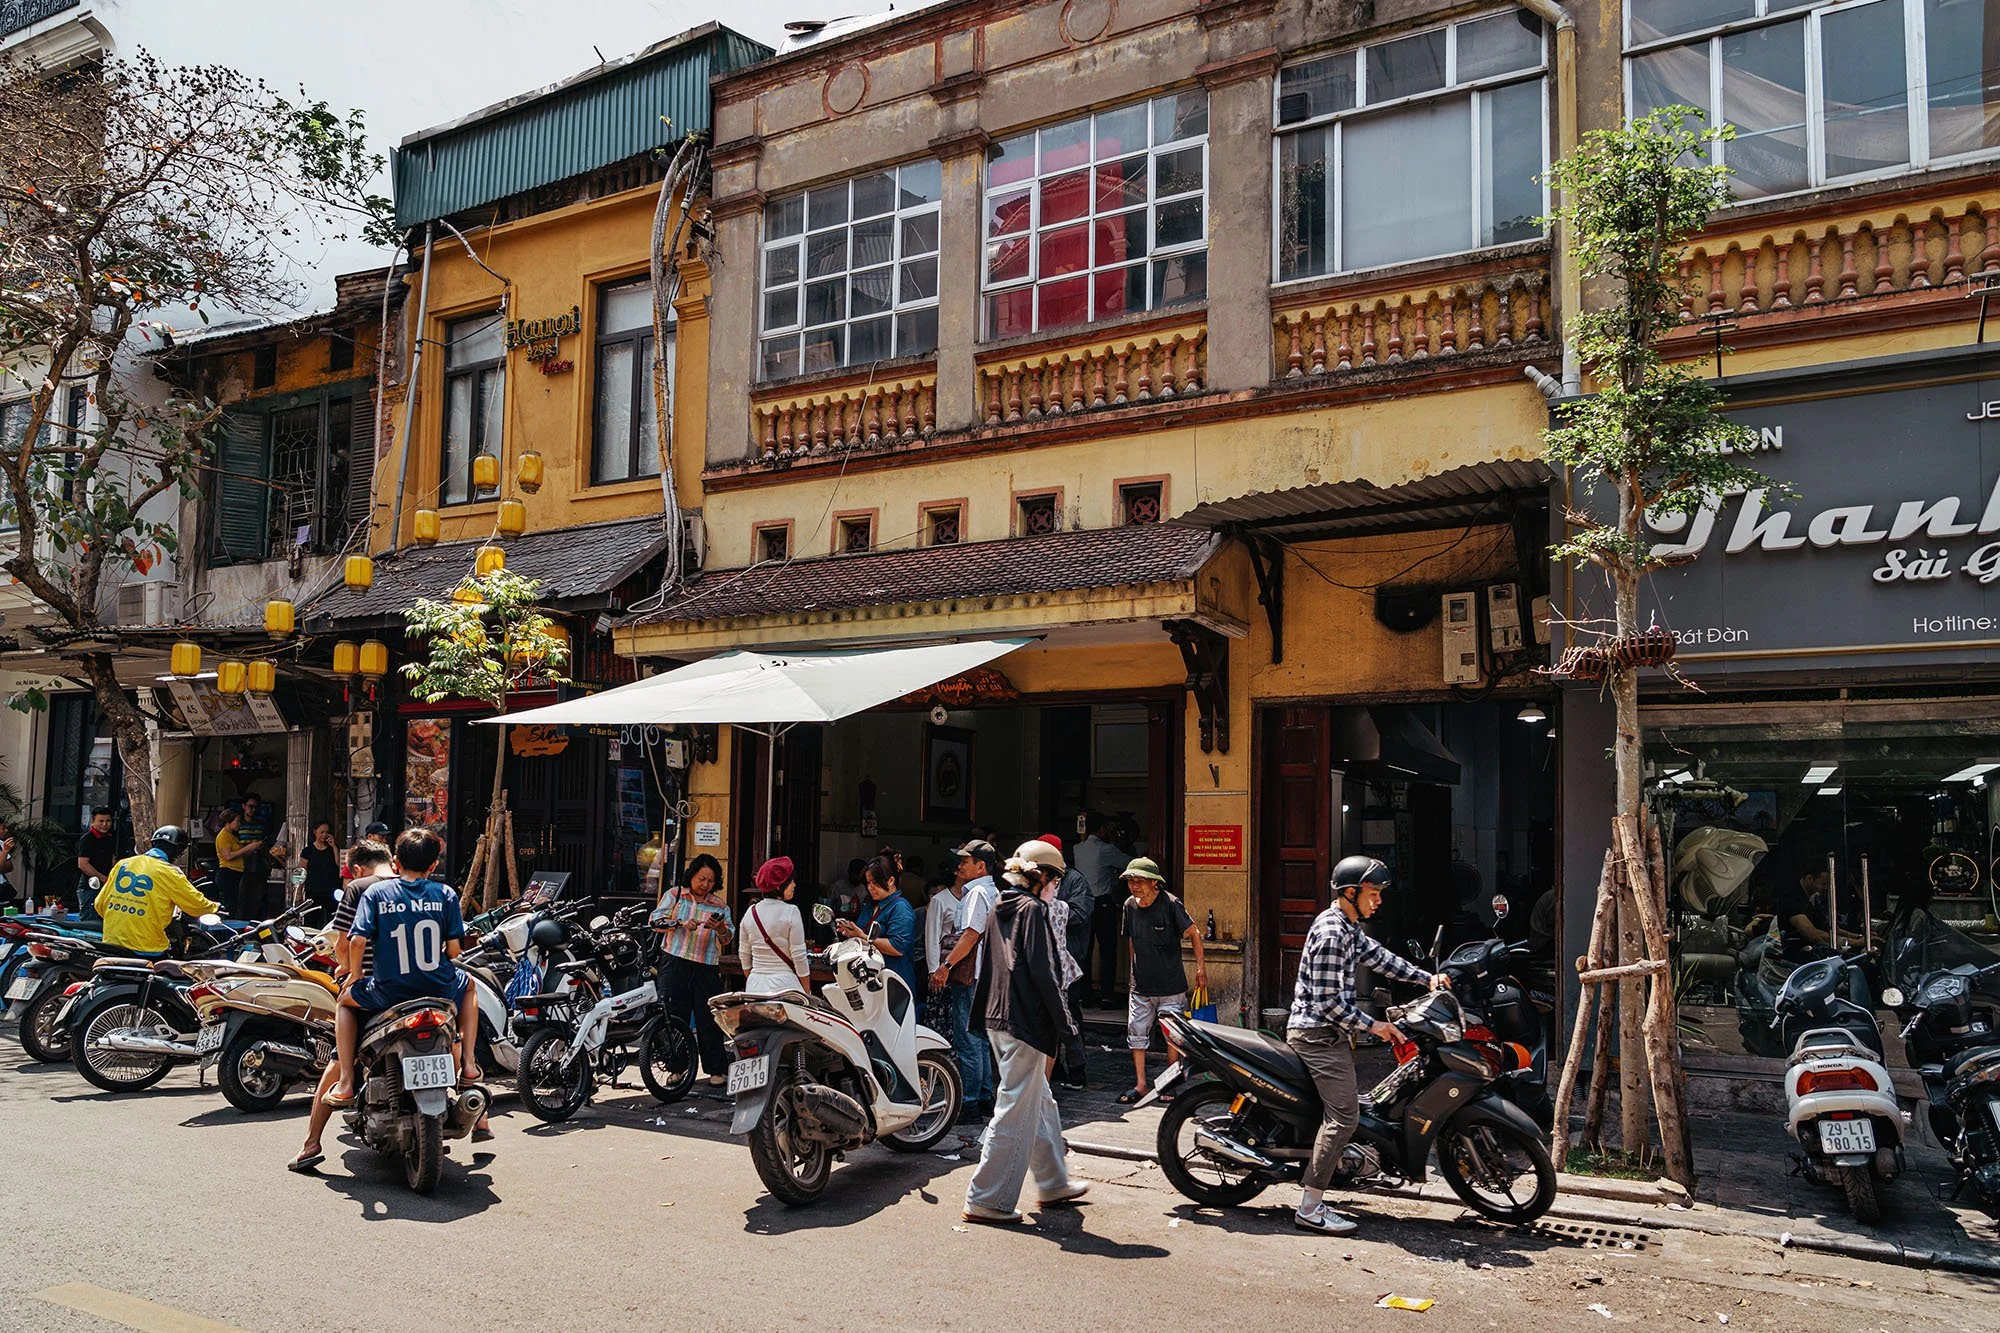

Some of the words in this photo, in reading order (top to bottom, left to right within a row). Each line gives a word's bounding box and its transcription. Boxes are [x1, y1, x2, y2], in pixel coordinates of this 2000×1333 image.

[1872, 548, 1952, 582] Sài
[1913, 615, 1997, 633] Hotline:
[1671, 628, 1704, 645] Bát
[1706, 626, 1749, 643] Đàn
[519, 848, 536, 856] OPEN
[115, 863, 153, 897] be
[411, 899, 443, 912] Nam
[390, 919, 440, 975] 10
[411, 1057, 446, 1072] 30-K8
[734, 1058, 763, 1078] 29-P1
[412, 1071, 448, 1087] 4903
[730, 1071, 765, 1092] 670.19
[1827, 1121, 1865, 1137] 29-L1
